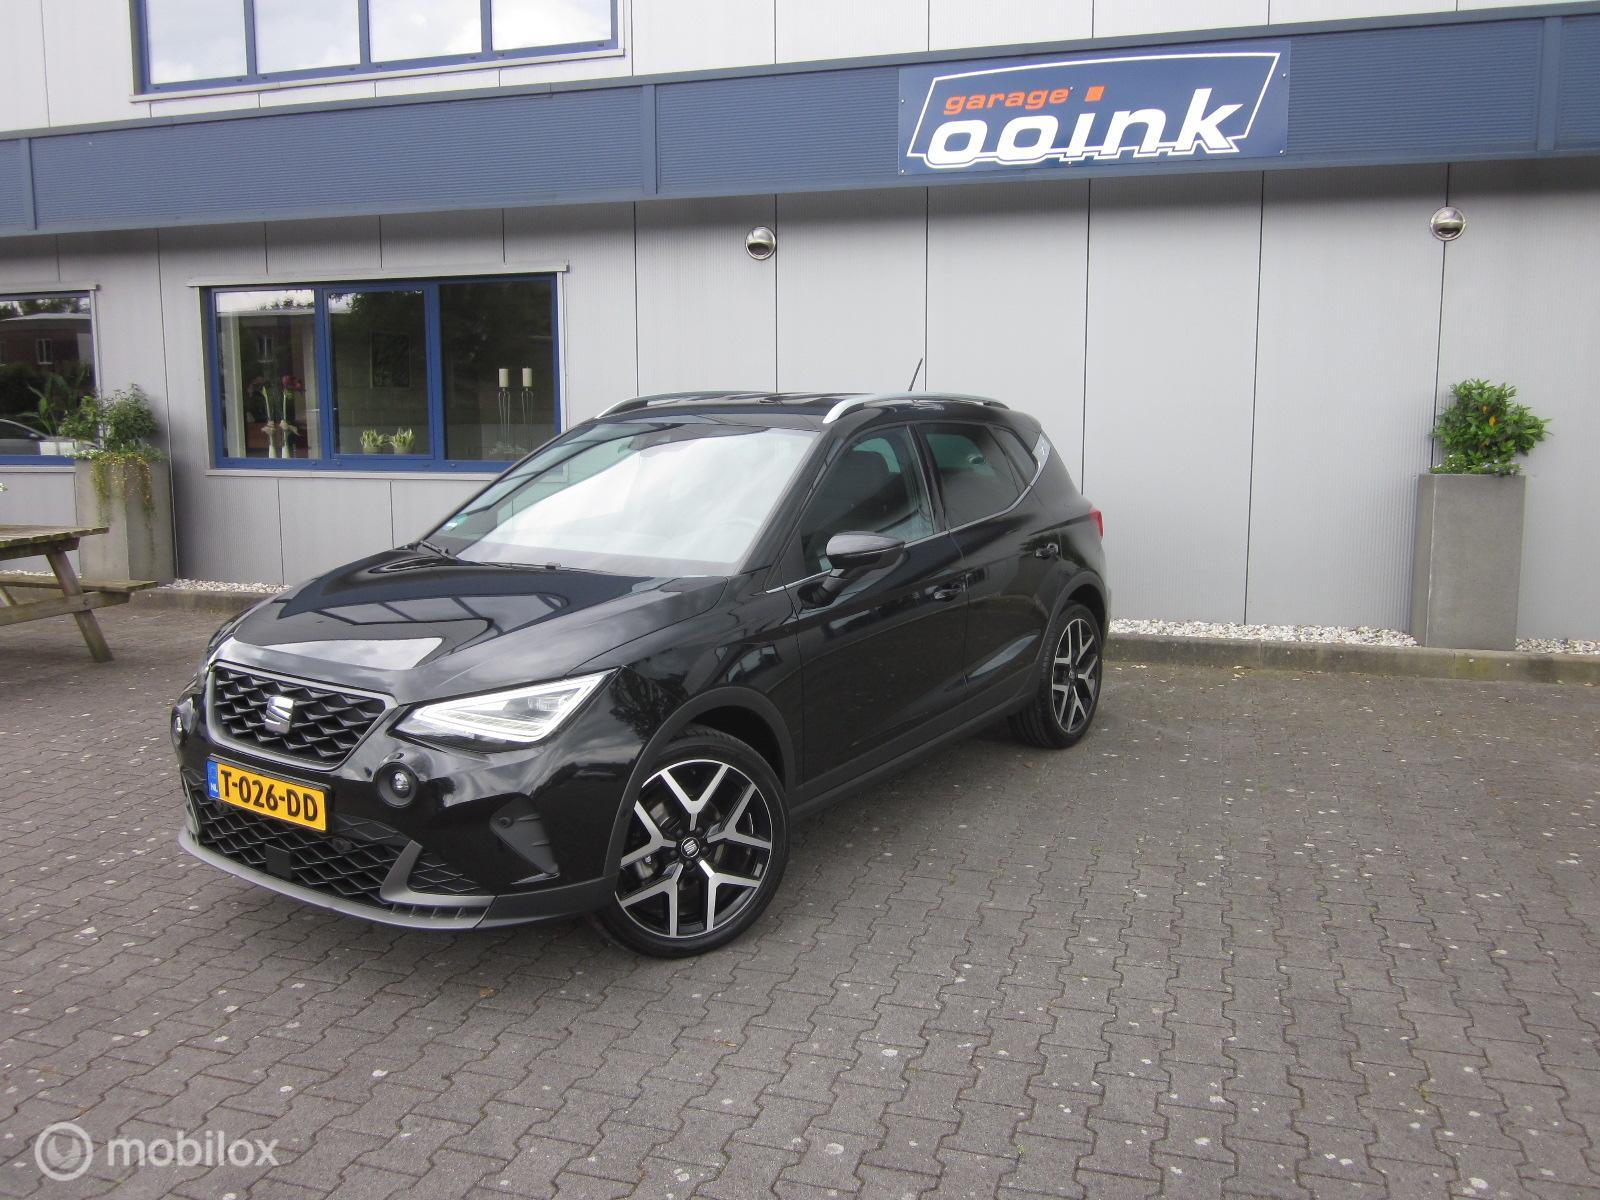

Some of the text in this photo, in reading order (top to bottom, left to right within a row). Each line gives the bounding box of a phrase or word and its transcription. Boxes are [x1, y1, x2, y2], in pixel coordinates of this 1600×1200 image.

[943, 86, 1070, 116] garage
[926, 86, 1244, 165] ooink
[210, 782, 218, 792] NL
[220, 769, 318, 822] T-026-DD
